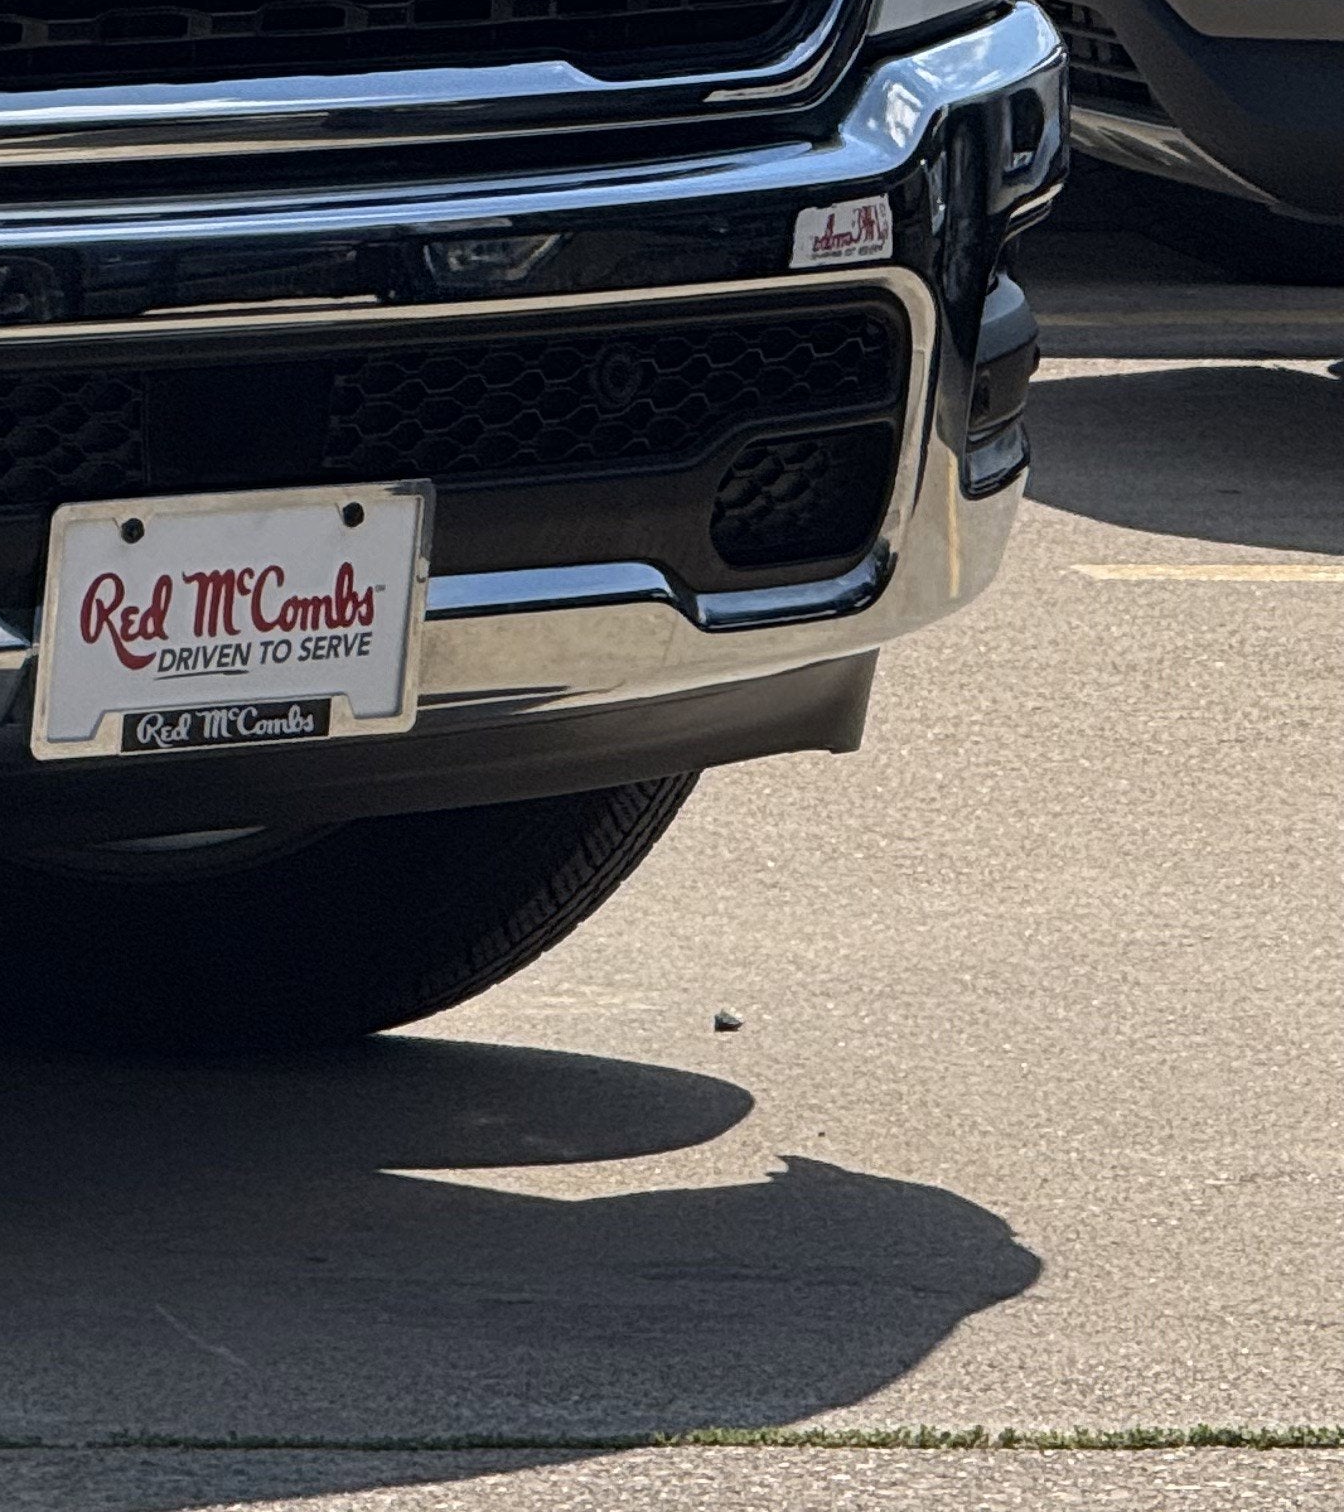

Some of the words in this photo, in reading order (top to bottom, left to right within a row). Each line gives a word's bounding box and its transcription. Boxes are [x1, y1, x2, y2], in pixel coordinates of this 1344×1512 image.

[80, 572, 173, 671] Red
[183, 562, 375, 637] McCombs
[157, 641, 252, 673] DRIVEN
[260, 639, 292, 665] TO
[298, 632, 373, 662] SERVE
[136, 713, 192, 748] Red
[195, 704, 315, 738] McCombs
